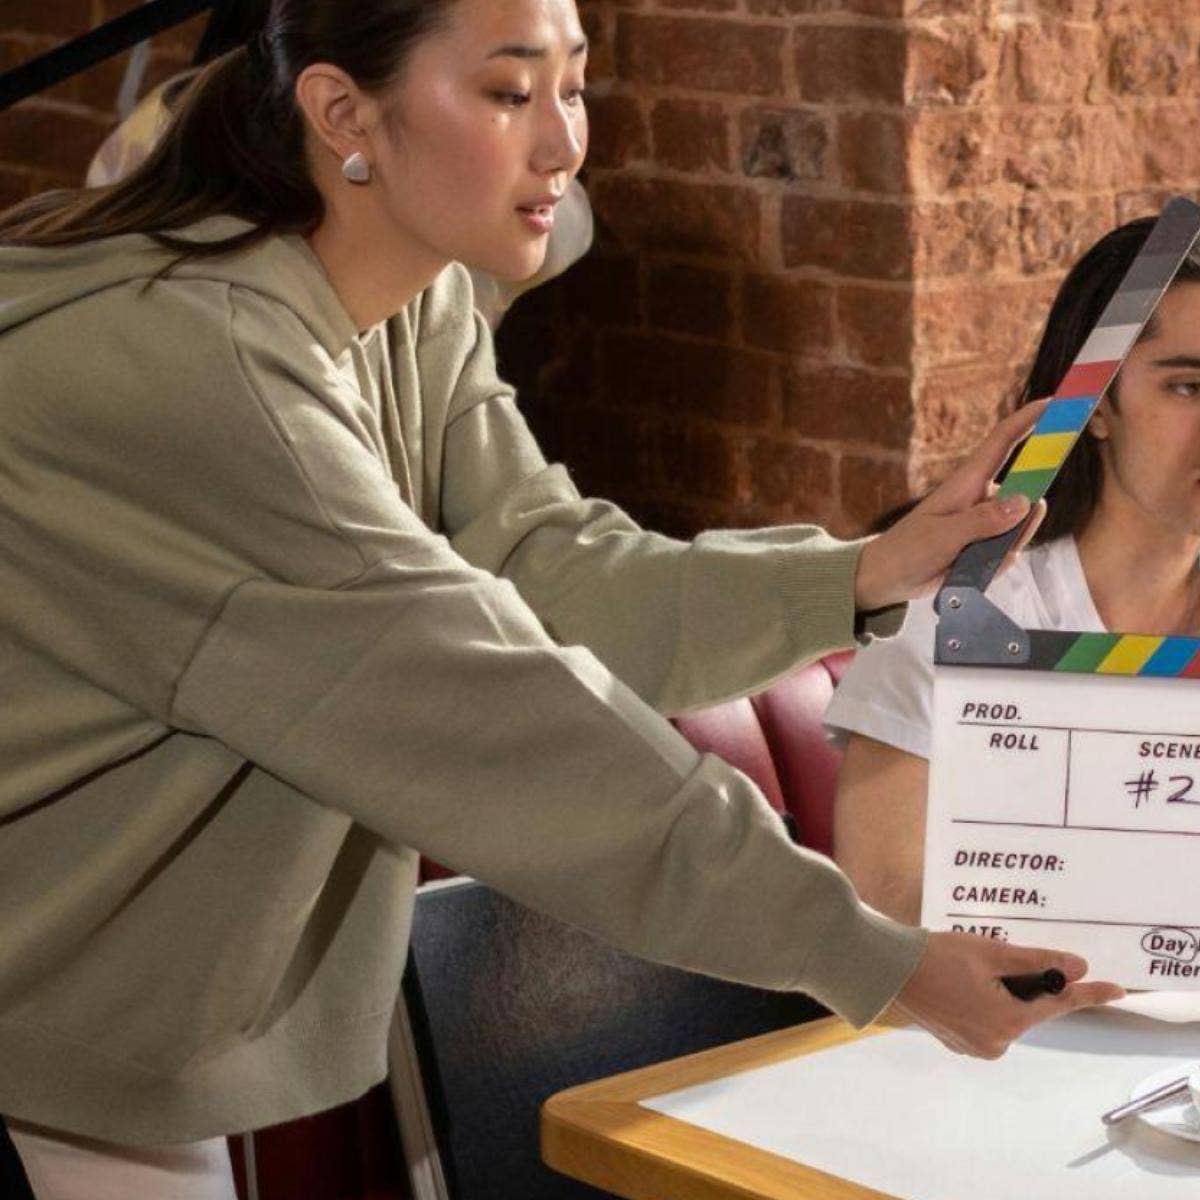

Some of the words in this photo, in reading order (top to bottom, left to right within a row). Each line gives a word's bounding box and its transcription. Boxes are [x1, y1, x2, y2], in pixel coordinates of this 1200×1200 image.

[962, 702, 1022, 720] PROD.
[989, 732, 1040, 751] ROLL
[954, 850, 1065, 871] DIRECTOR:
[952, 885, 1046, 907] CAMERA:
